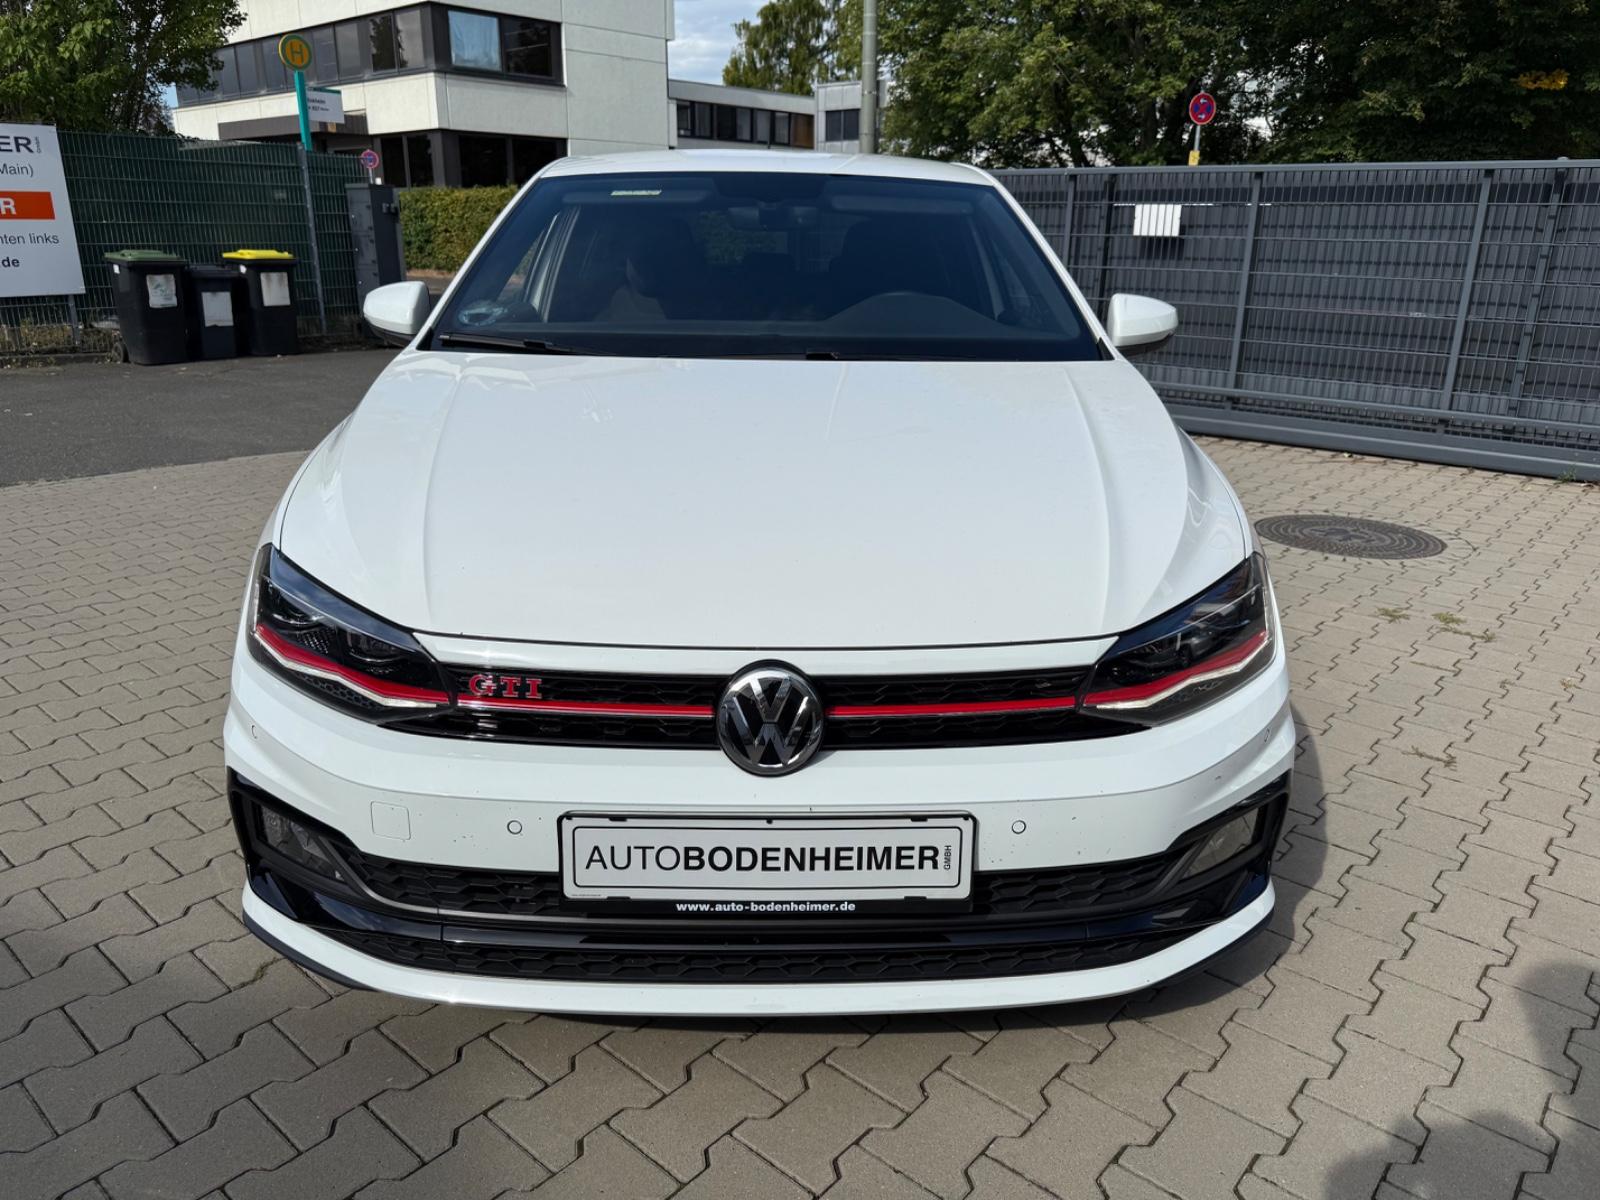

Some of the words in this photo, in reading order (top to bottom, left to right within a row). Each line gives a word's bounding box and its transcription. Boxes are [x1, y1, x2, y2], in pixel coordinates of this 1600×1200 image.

[289, 41, 304, 64] H
[0, 135, 34, 153] ER
[29, 233, 60, 245] links
[468, 673, 542, 699] GTI
[585, 845, 940, 871] AUTOBODENHEIMER
[676, 901, 856, 912] www.auto-bodenheimer.de
